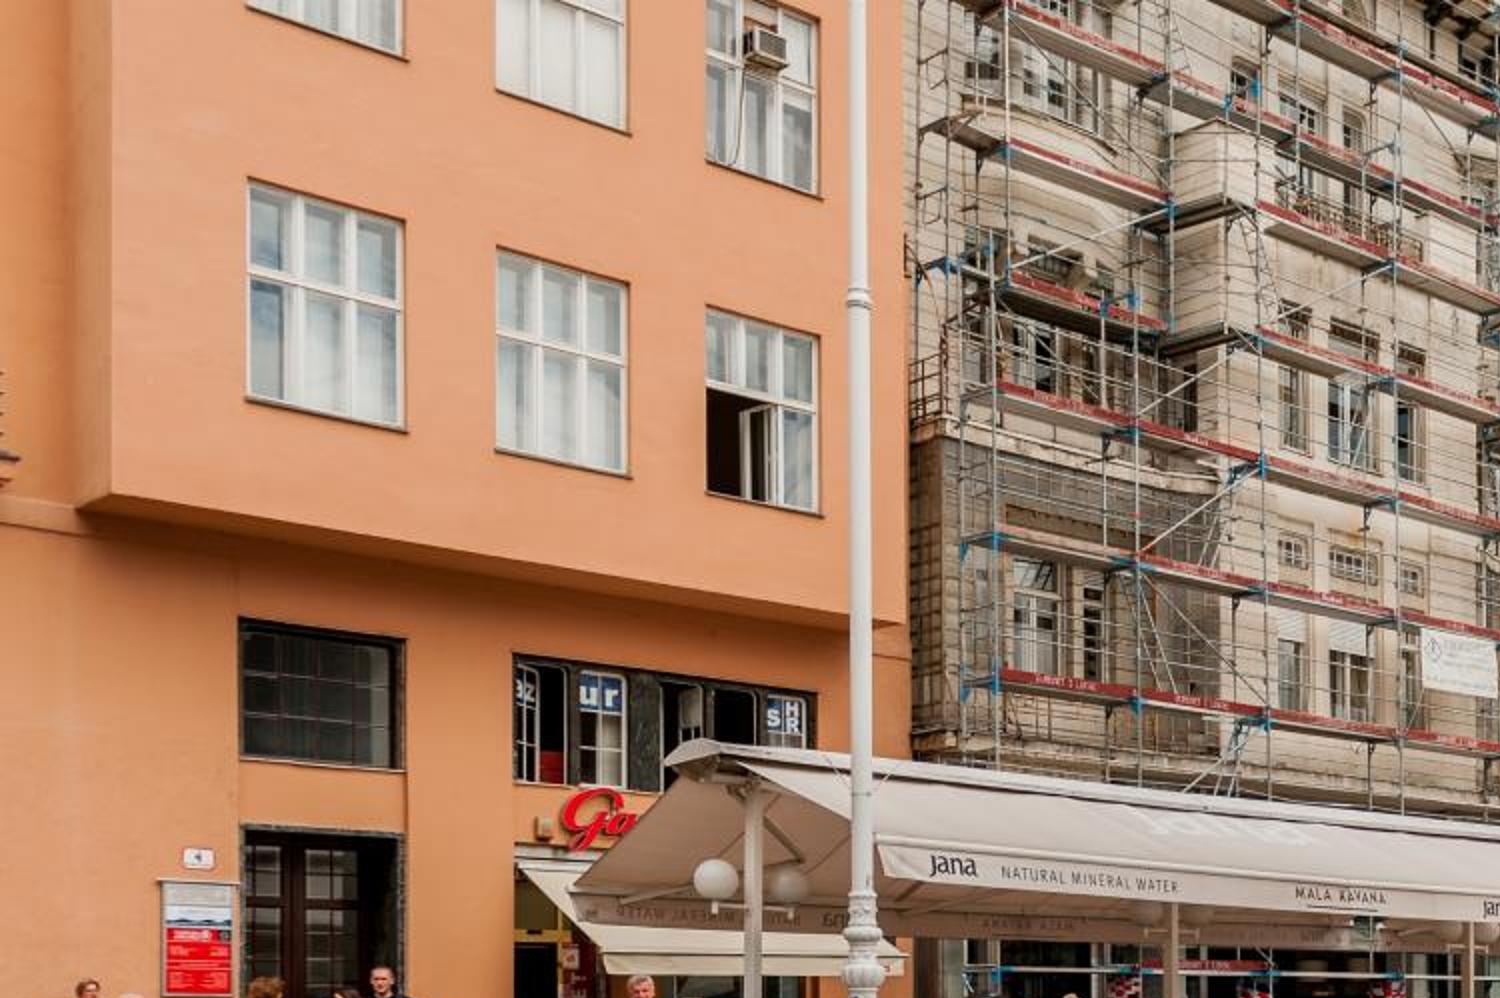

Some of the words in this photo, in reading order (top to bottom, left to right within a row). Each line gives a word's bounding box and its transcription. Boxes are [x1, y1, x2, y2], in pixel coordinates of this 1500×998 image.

[1001, 866, 1066, 885] NATURAL
[1071, 871, 1131, 890] MINERAL
[1135, 877, 1178, 893] WATER
[1295, 886, 1332, 901] MALA
[1339, 888, 1387, 904] KAVANA
